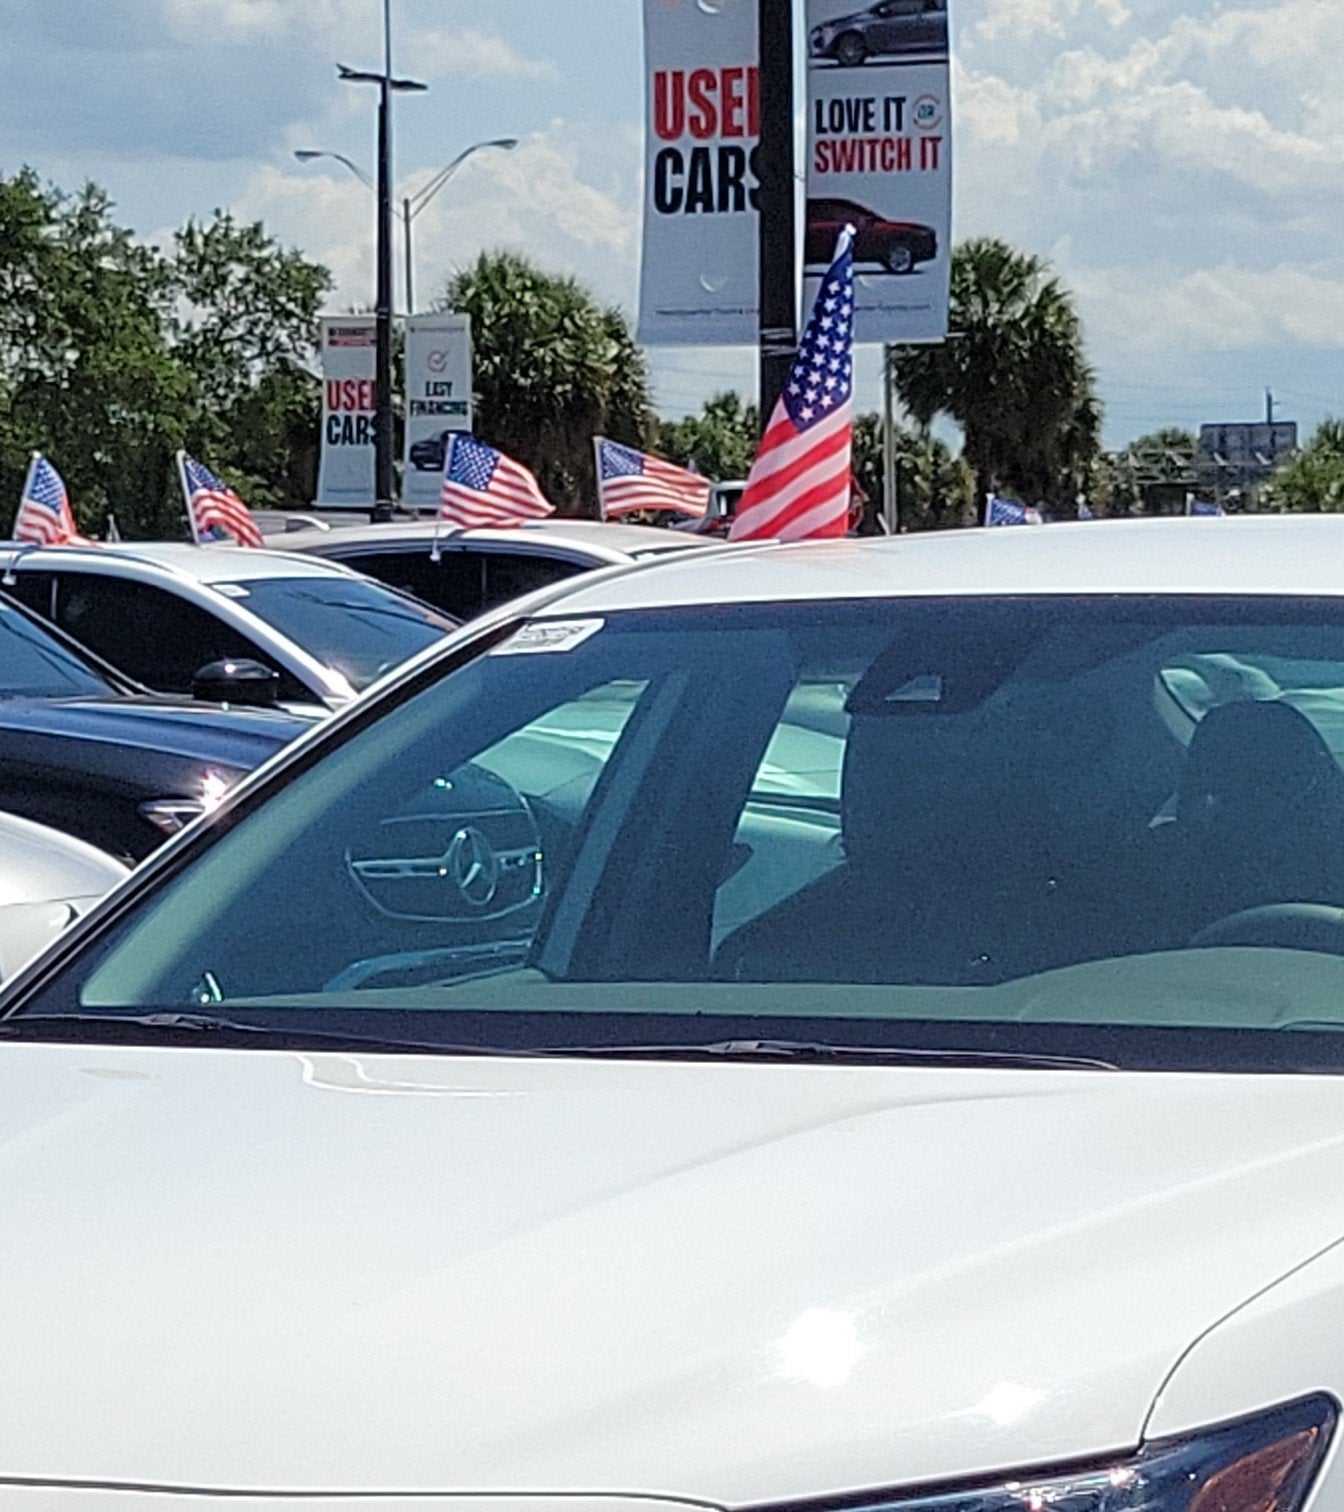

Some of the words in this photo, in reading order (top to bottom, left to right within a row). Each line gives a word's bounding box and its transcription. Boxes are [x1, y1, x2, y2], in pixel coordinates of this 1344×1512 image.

[816, 97, 875, 134] LOVE
[883, 97, 906, 132] IT
[814, 137, 910, 173] SWITCH
[919, 137, 942, 170] IT
